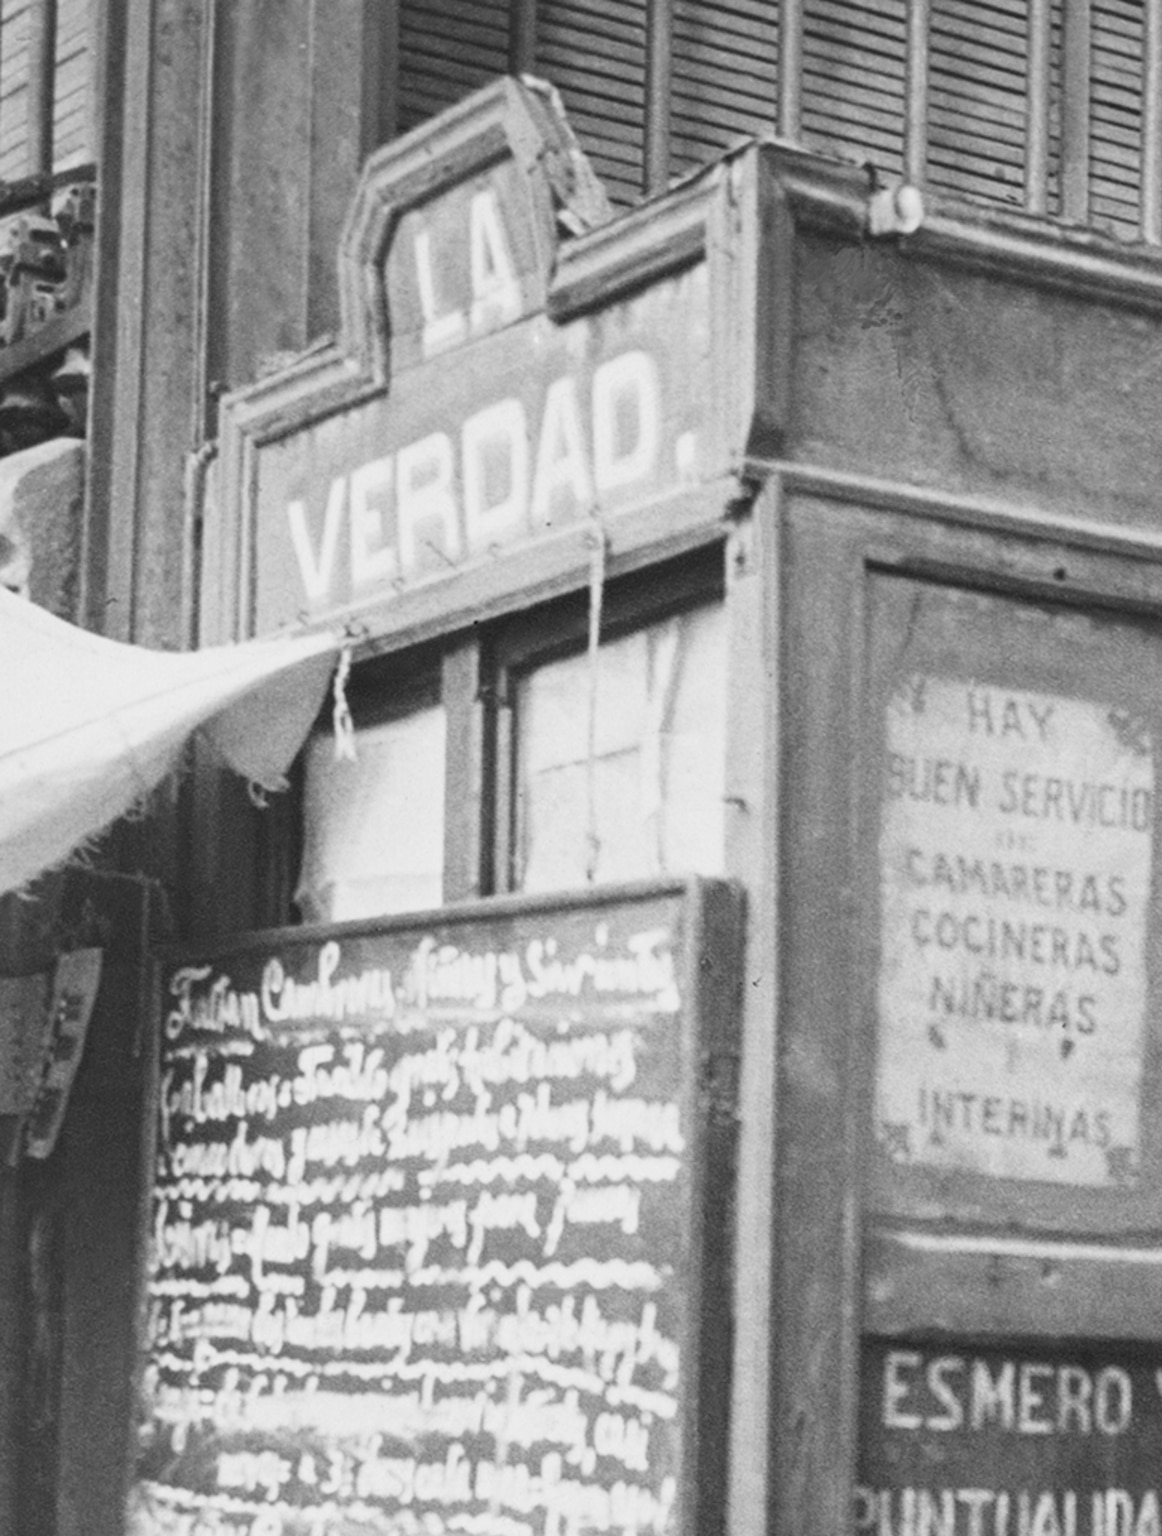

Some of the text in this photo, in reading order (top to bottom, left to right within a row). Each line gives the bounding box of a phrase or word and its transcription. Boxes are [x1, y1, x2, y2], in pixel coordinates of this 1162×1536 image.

[413, 192, 522, 357] LA
[286, 349, 697, 602] VERDAD.
[966, 692, 1056, 742] HAY
[999, 771, 1150, 833] SERVICIO
[903, 849, 1128, 917] CAMARERAS
[911, 908, 1121, 976] COCINERAS
[929, 968, 1097, 1036] NIÑERAS
[884, 1352, 1132, 1435] ESMERO
